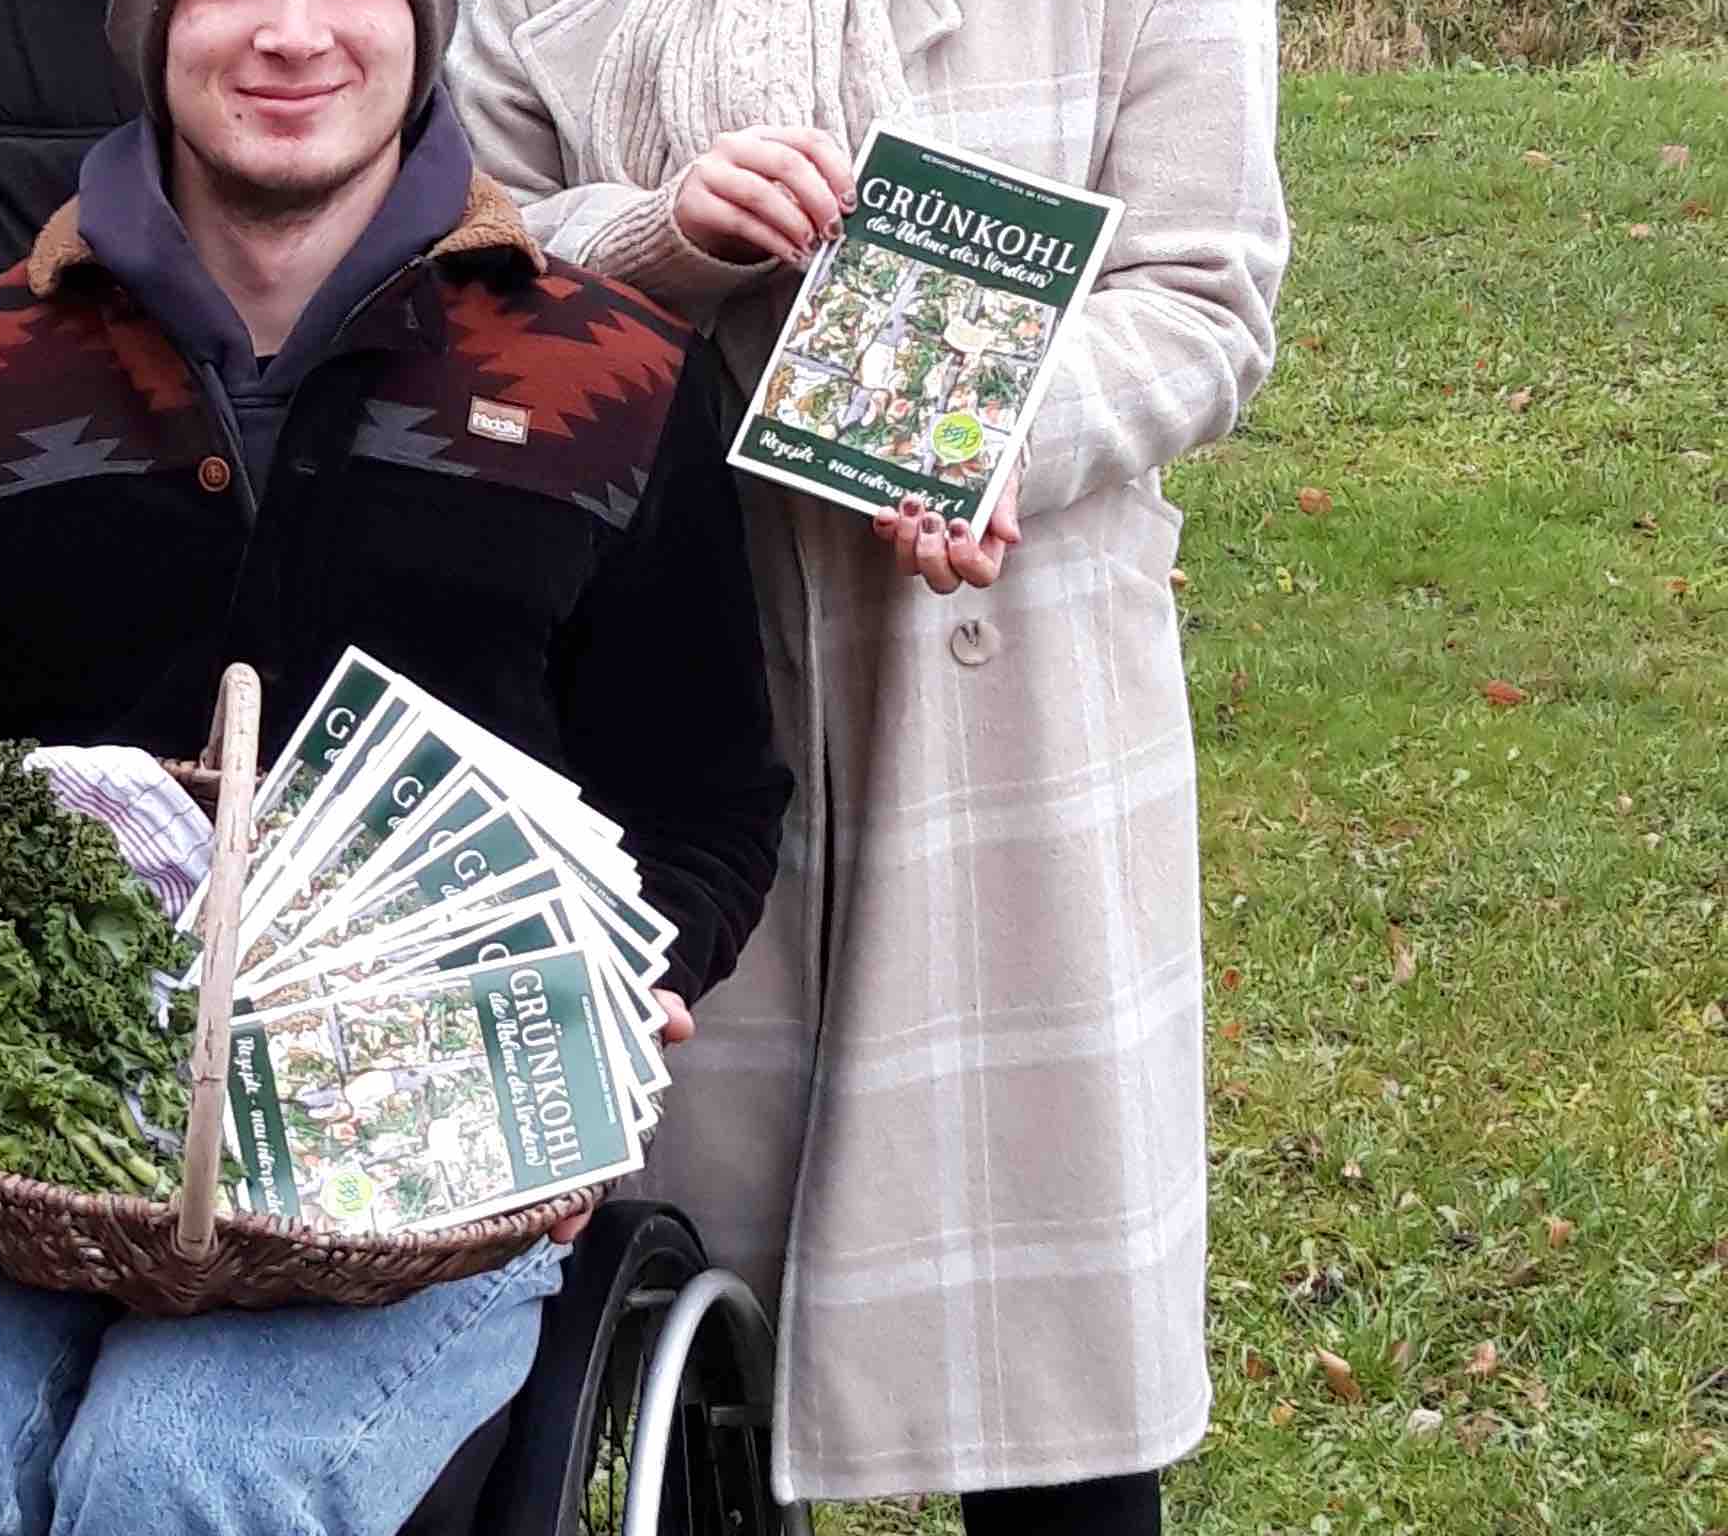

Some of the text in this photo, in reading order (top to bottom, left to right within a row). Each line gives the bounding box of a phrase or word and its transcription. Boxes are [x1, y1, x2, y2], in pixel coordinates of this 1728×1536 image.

[861, 176, 1077, 275] GRÜNKOHL
[866, 214, 896, 235] die
[949, 244, 980, 267] des
[510, 968, 584, 1177] GRÜNKOHL
